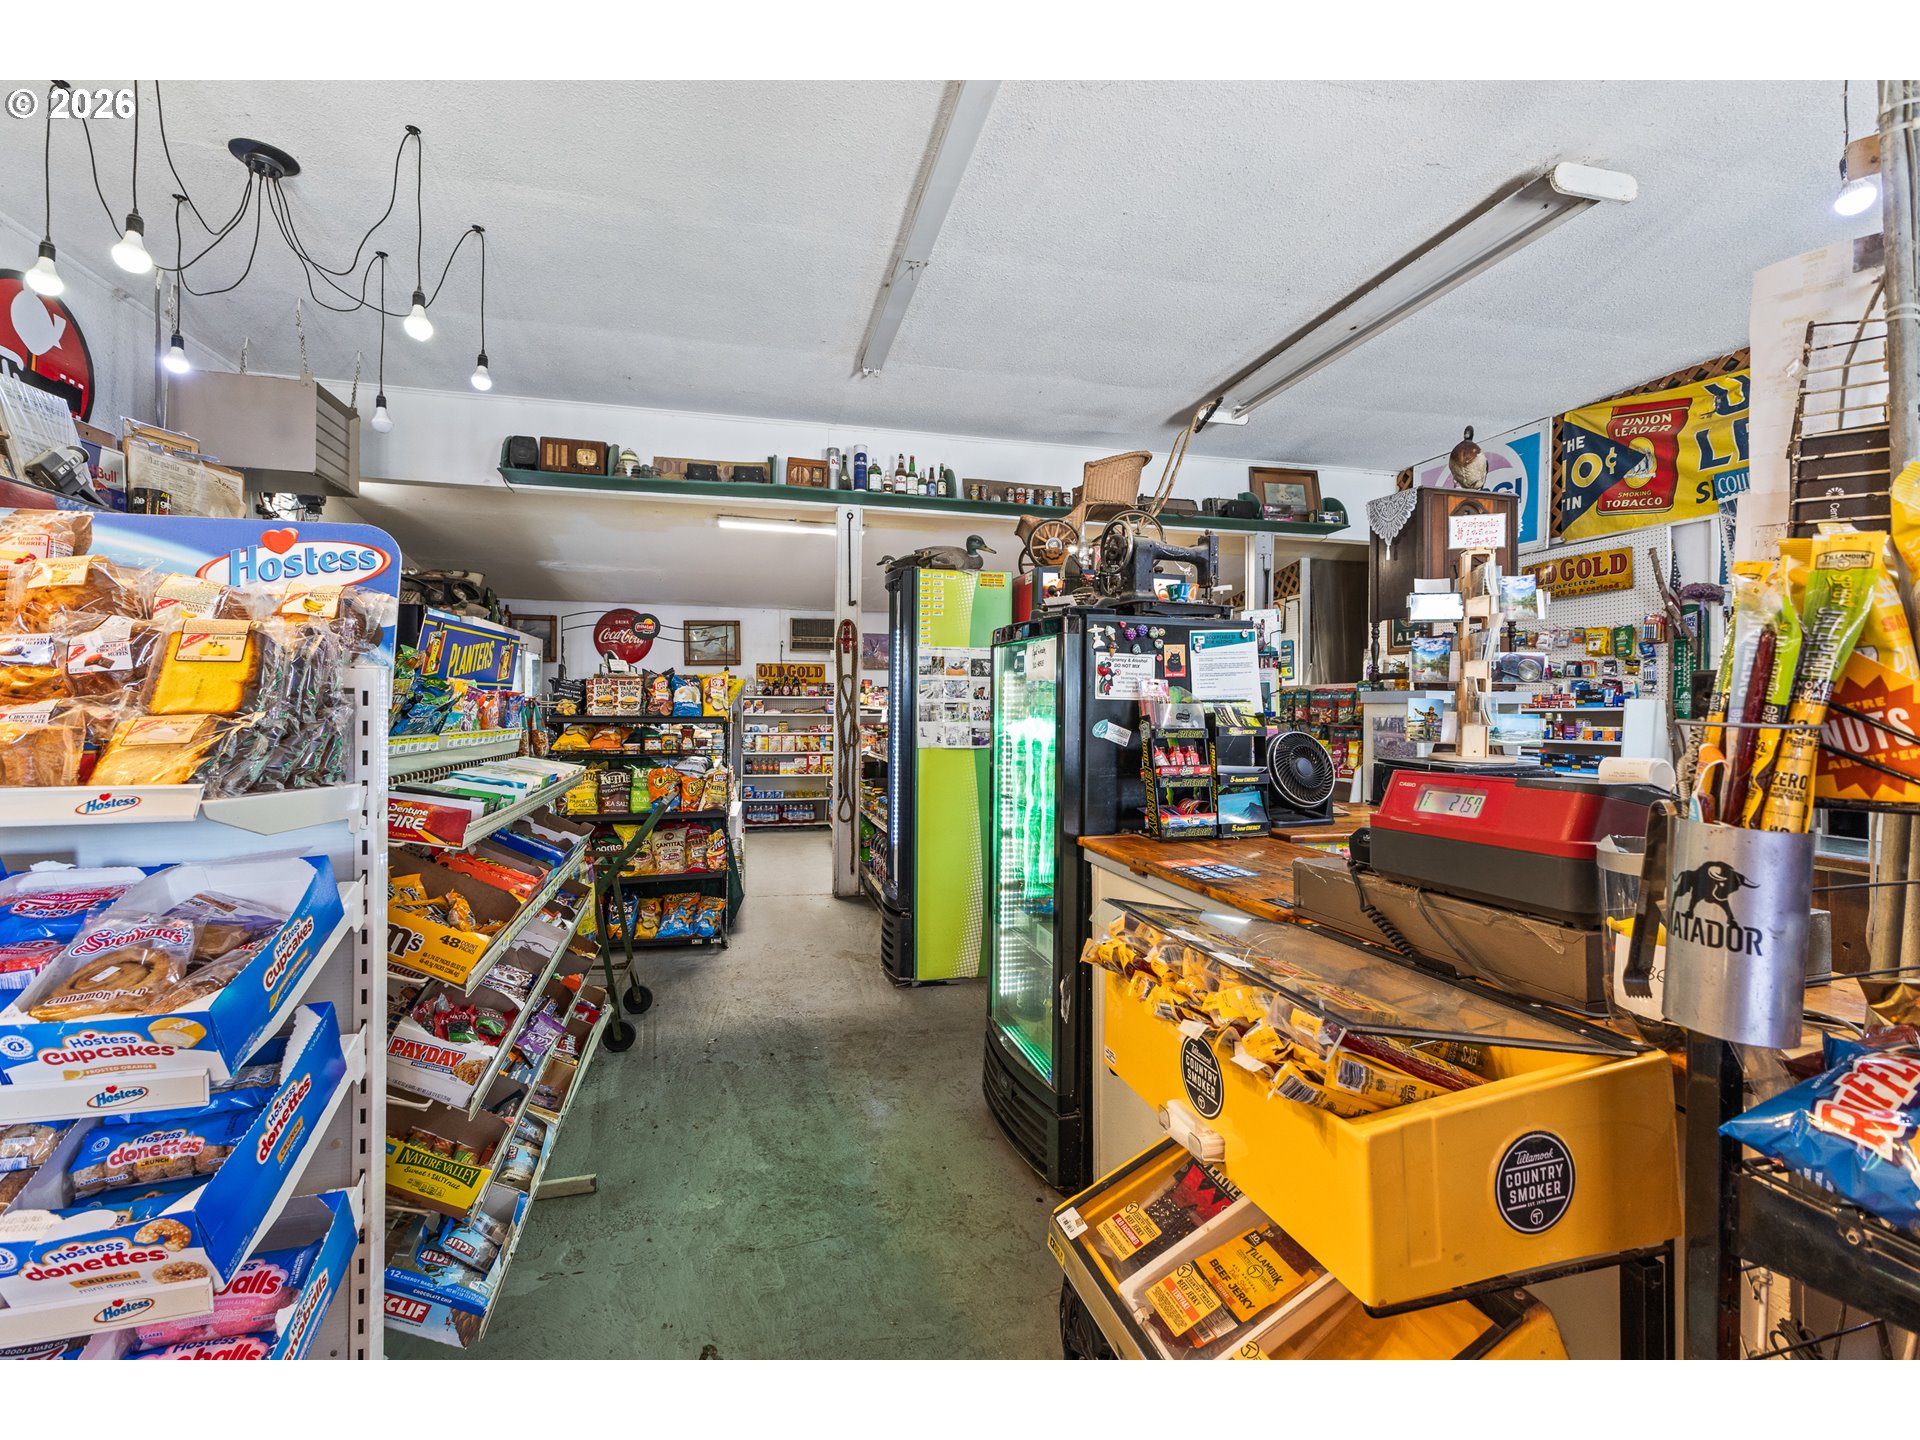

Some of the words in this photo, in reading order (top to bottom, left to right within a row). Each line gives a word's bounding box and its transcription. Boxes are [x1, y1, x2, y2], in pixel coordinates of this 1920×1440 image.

[1615, 424, 1672, 437] LEADER
[1623, 413, 1673, 428] UNION
[1606, 497, 1664, 509] TOBACCO
[1618, 490, 1652, 498] SMOKING
[229, 544, 377, 588] Hostess
[1560, 553, 1628, 581] GOLD
[1824, 553, 1866, 563] TILLAMOOK
[447, 640, 495, 678] PLANTERS
[758, 665, 785, 678] OLD
[787, 666, 824, 678] GOLD
[1821, 707, 1915, 757] NUTS
[1772, 771, 1808, 791] ZERO
[85, 796, 137, 814] Hostess
[389, 803, 429, 816] Dentyne
[388, 813, 427, 830] FIRE
[72, 928, 186, 955] Svenhard's
[439, 935, 461, 949] 48
[1670, 909, 1764, 957] ATADOR
[264, 918, 314, 989] Cupcakes
[69, 1034, 138, 1049] Hostess
[42, 1044, 176, 1066] Cupcakes
[388, 1038, 465, 1068] PAYDAY
[86, 1065, 120, 1075] FROSTED
[1185, 1054, 1218, 1086] COUNTRY
[1187, 1068, 1216, 1099] SMOKER
[95, 1086, 145, 1107] Hostess
[258, 1076, 312, 1162] donettes
[136, 1131, 183, 1145] Hostess
[109, 1139, 203, 1166] donettes
[140, 1157, 170, 1167] CRUNCH
[1514, 1147, 1554, 1165] Tillamook
[400, 1149, 443, 1170] NATURE
[443, 1162, 479, 1186] VALLEY
[403, 1166, 427, 1176] Sweet
[1505, 1163, 1564, 1189] COUNTRY
[1509, 1180, 1562, 1204] SMOKER
[49, 1241, 126, 1263] Hostess
[25, 1249, 167, 1282] donettes
[1245, 1246, 1284, 1287] TILLAMOOK
[79, 1273, 133, 1286] CRUNCH
[79, 1286, 104, 1295] mini
[105, 1279, 148, 1290] donuts
[1209, 1258, 1232, 1282] BEEF
[1228, 1283, 1256, 1310] JERKY
[412, 1288, 440, 1301] CHOCOLATE
[1171, 1287, 1191, 1311] TERIYAKI
[103, 1299, 150, 1322] Hostess
[385, 1296, 427, 1319] CLIF
[173, 1336, 239, 1354] Hostess
